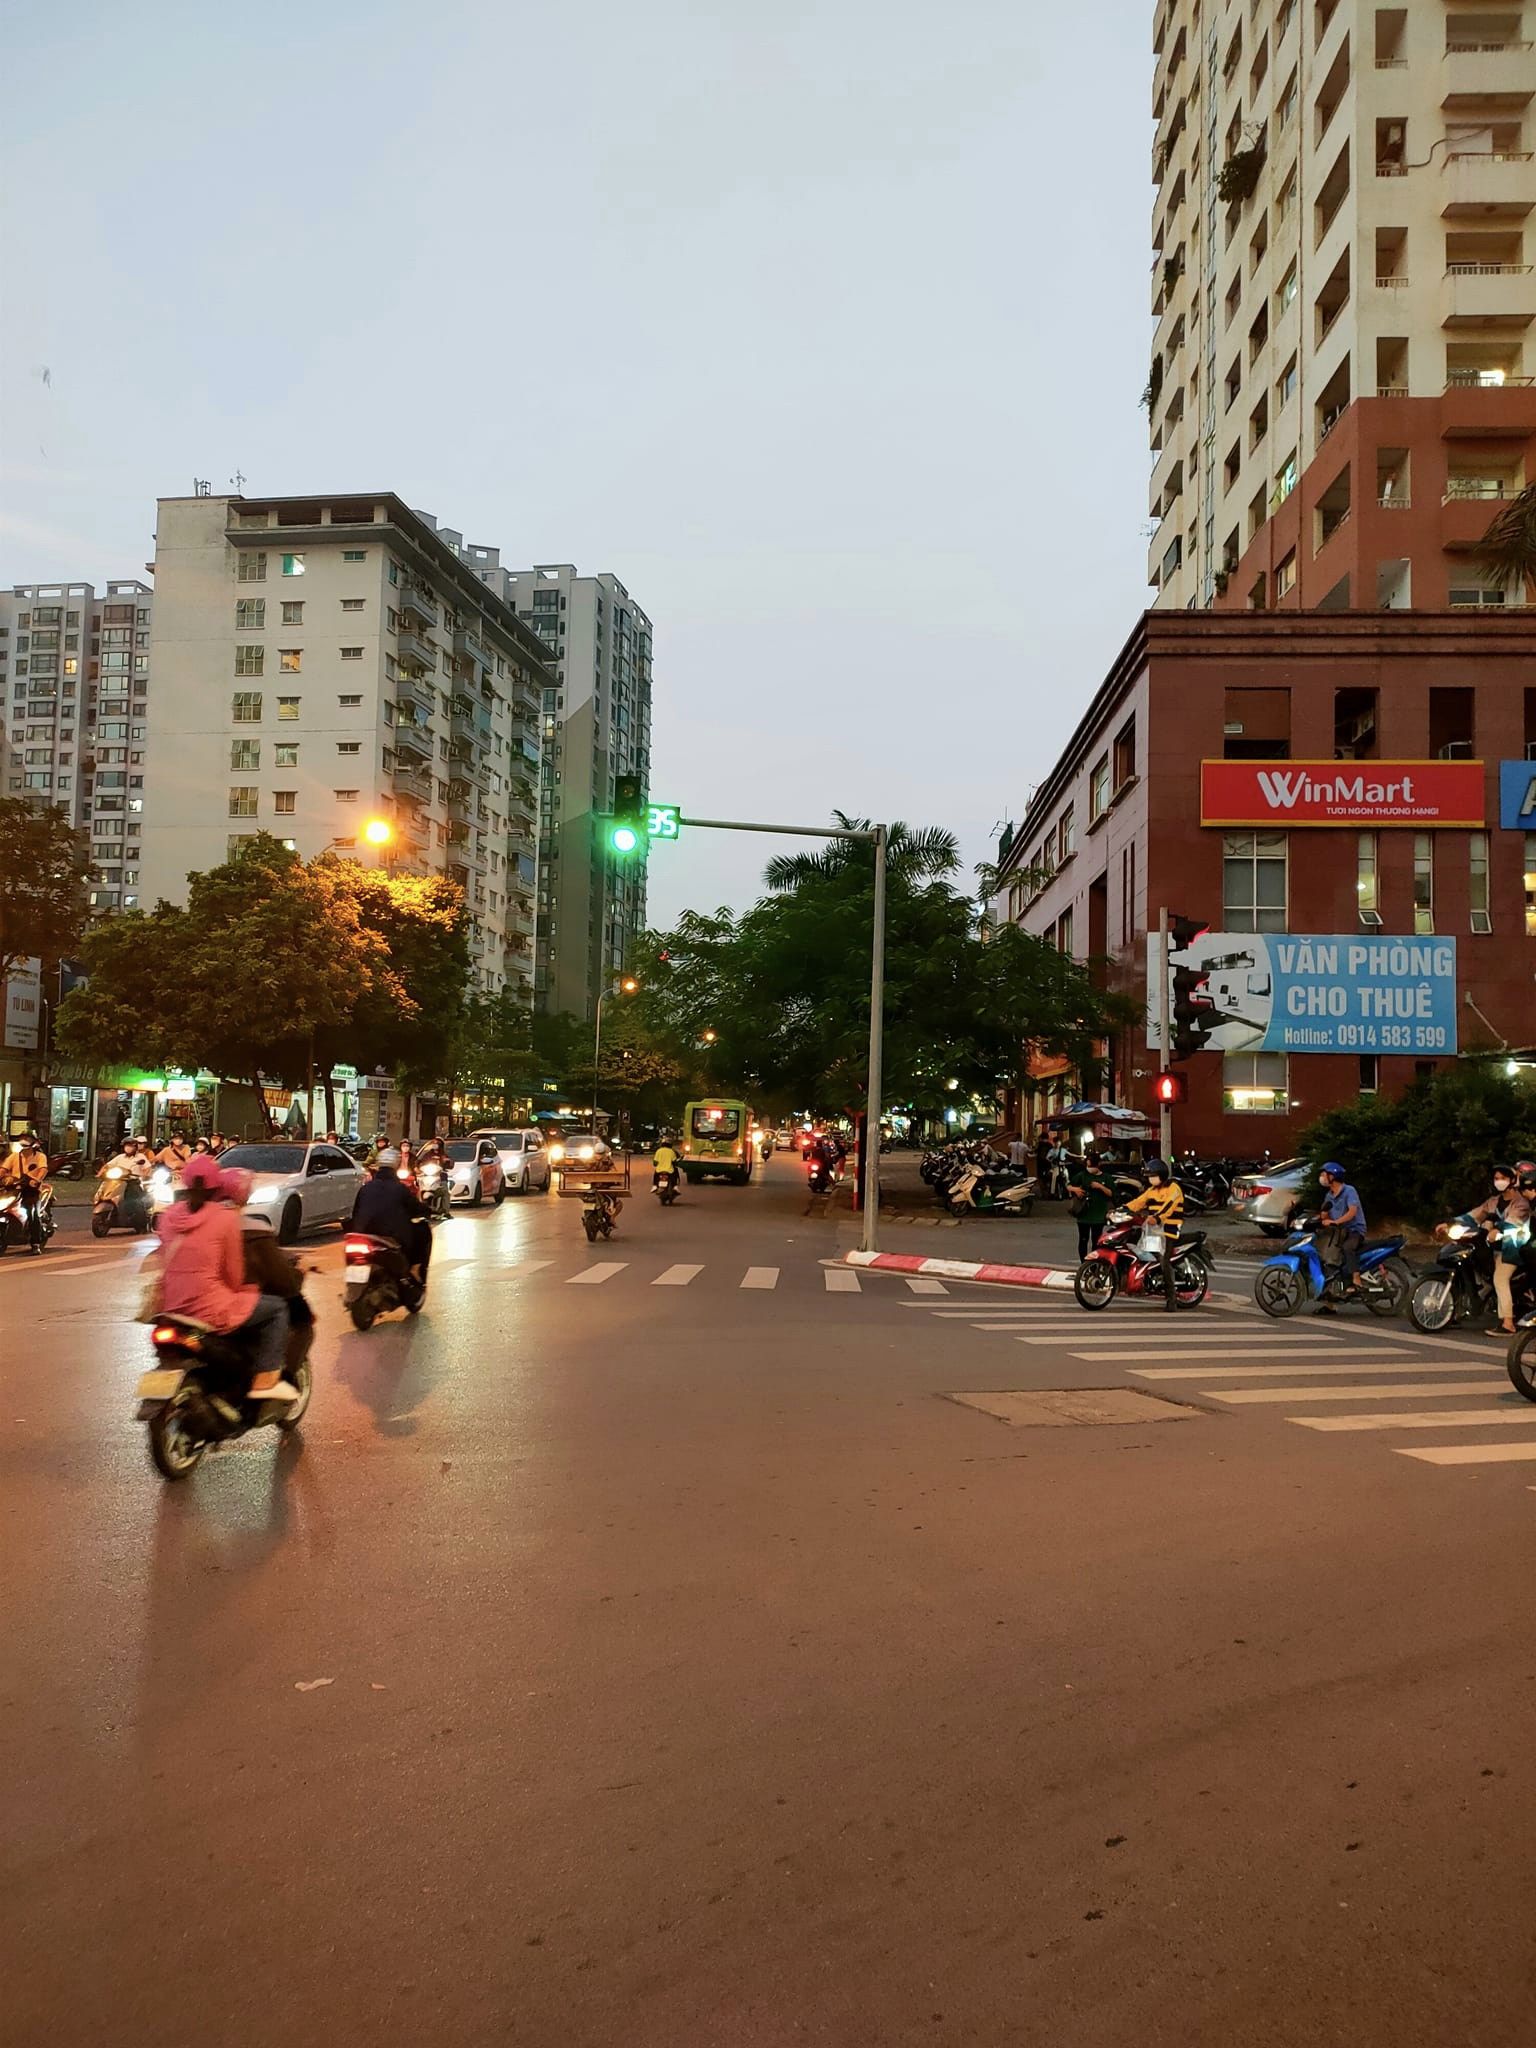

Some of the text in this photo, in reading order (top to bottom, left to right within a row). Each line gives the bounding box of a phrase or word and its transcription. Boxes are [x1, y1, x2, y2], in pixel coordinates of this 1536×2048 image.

[1257, 771, 1415, 808] WinMart
[647, 808, 677, 835] 35
[1348, 807, 1373, 815] NGON
[1277, 938, 1453, 976] VĂN PHÒNG
[1287, 982, 1433, 1018] CHO THUÊ
[1284, 1024, 1446, 1048] Hotline: 0914 583 599
